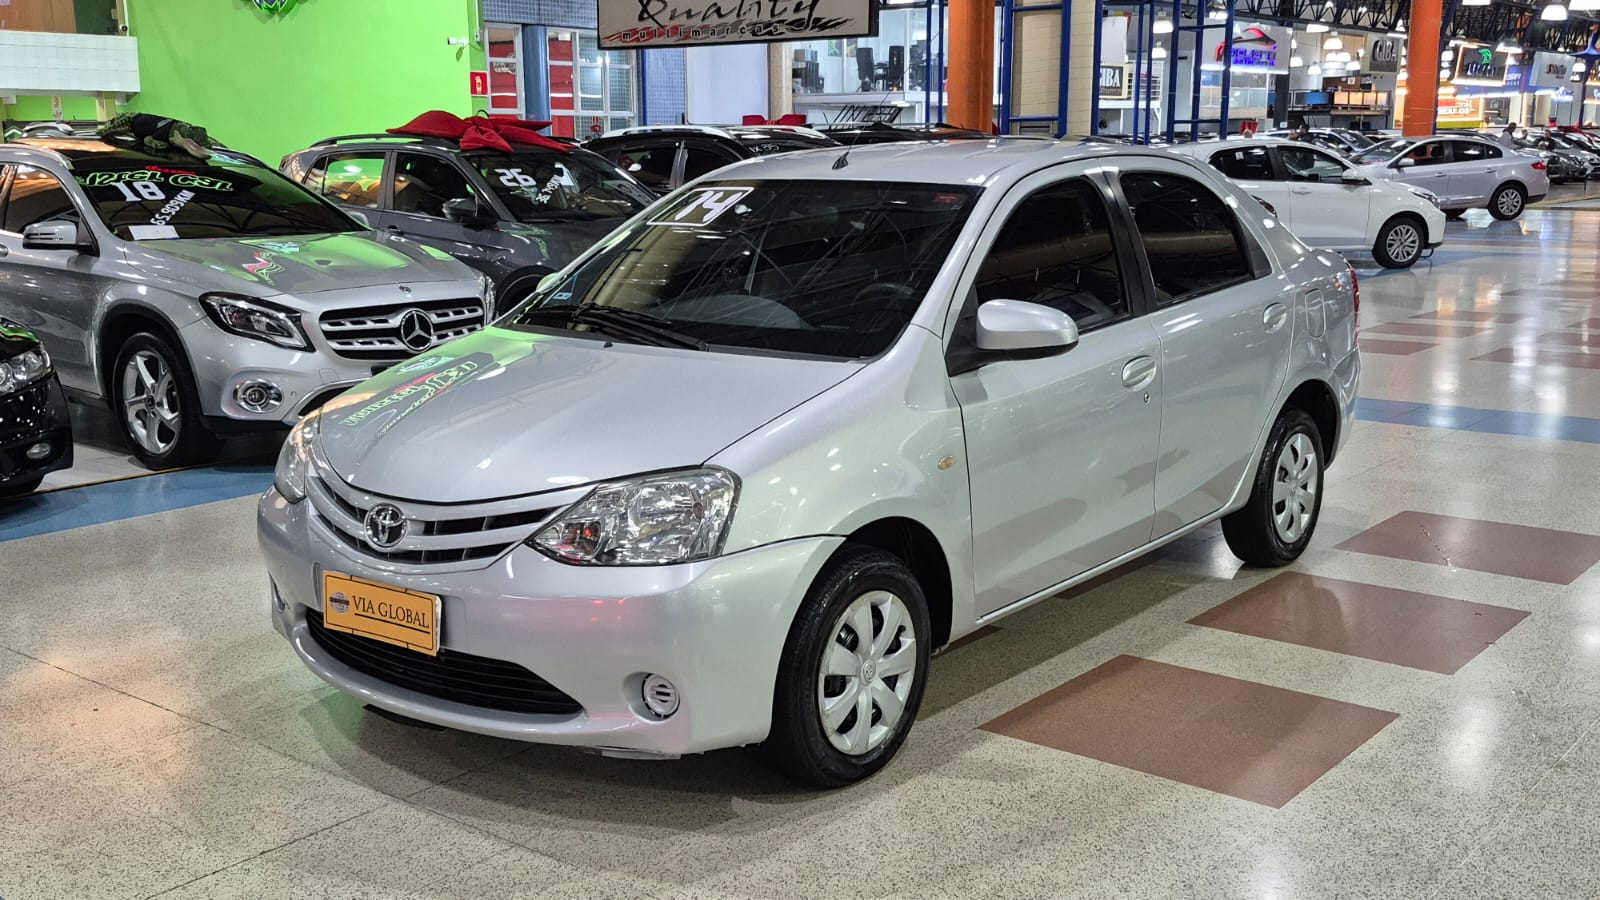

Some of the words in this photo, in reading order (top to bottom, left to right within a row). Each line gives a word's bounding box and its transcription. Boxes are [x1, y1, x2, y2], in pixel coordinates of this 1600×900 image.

[637, 0, 819, 29] Quality
[622, 23, 781, 40] multimarcas
[494, 168, 537, 187] 26
[112, 181, 166, 201] 18
[675, 190, 743, 223] 14
[352, 595, 375, 614] VIA
[378, 602, 429, 628] GLOBAL
